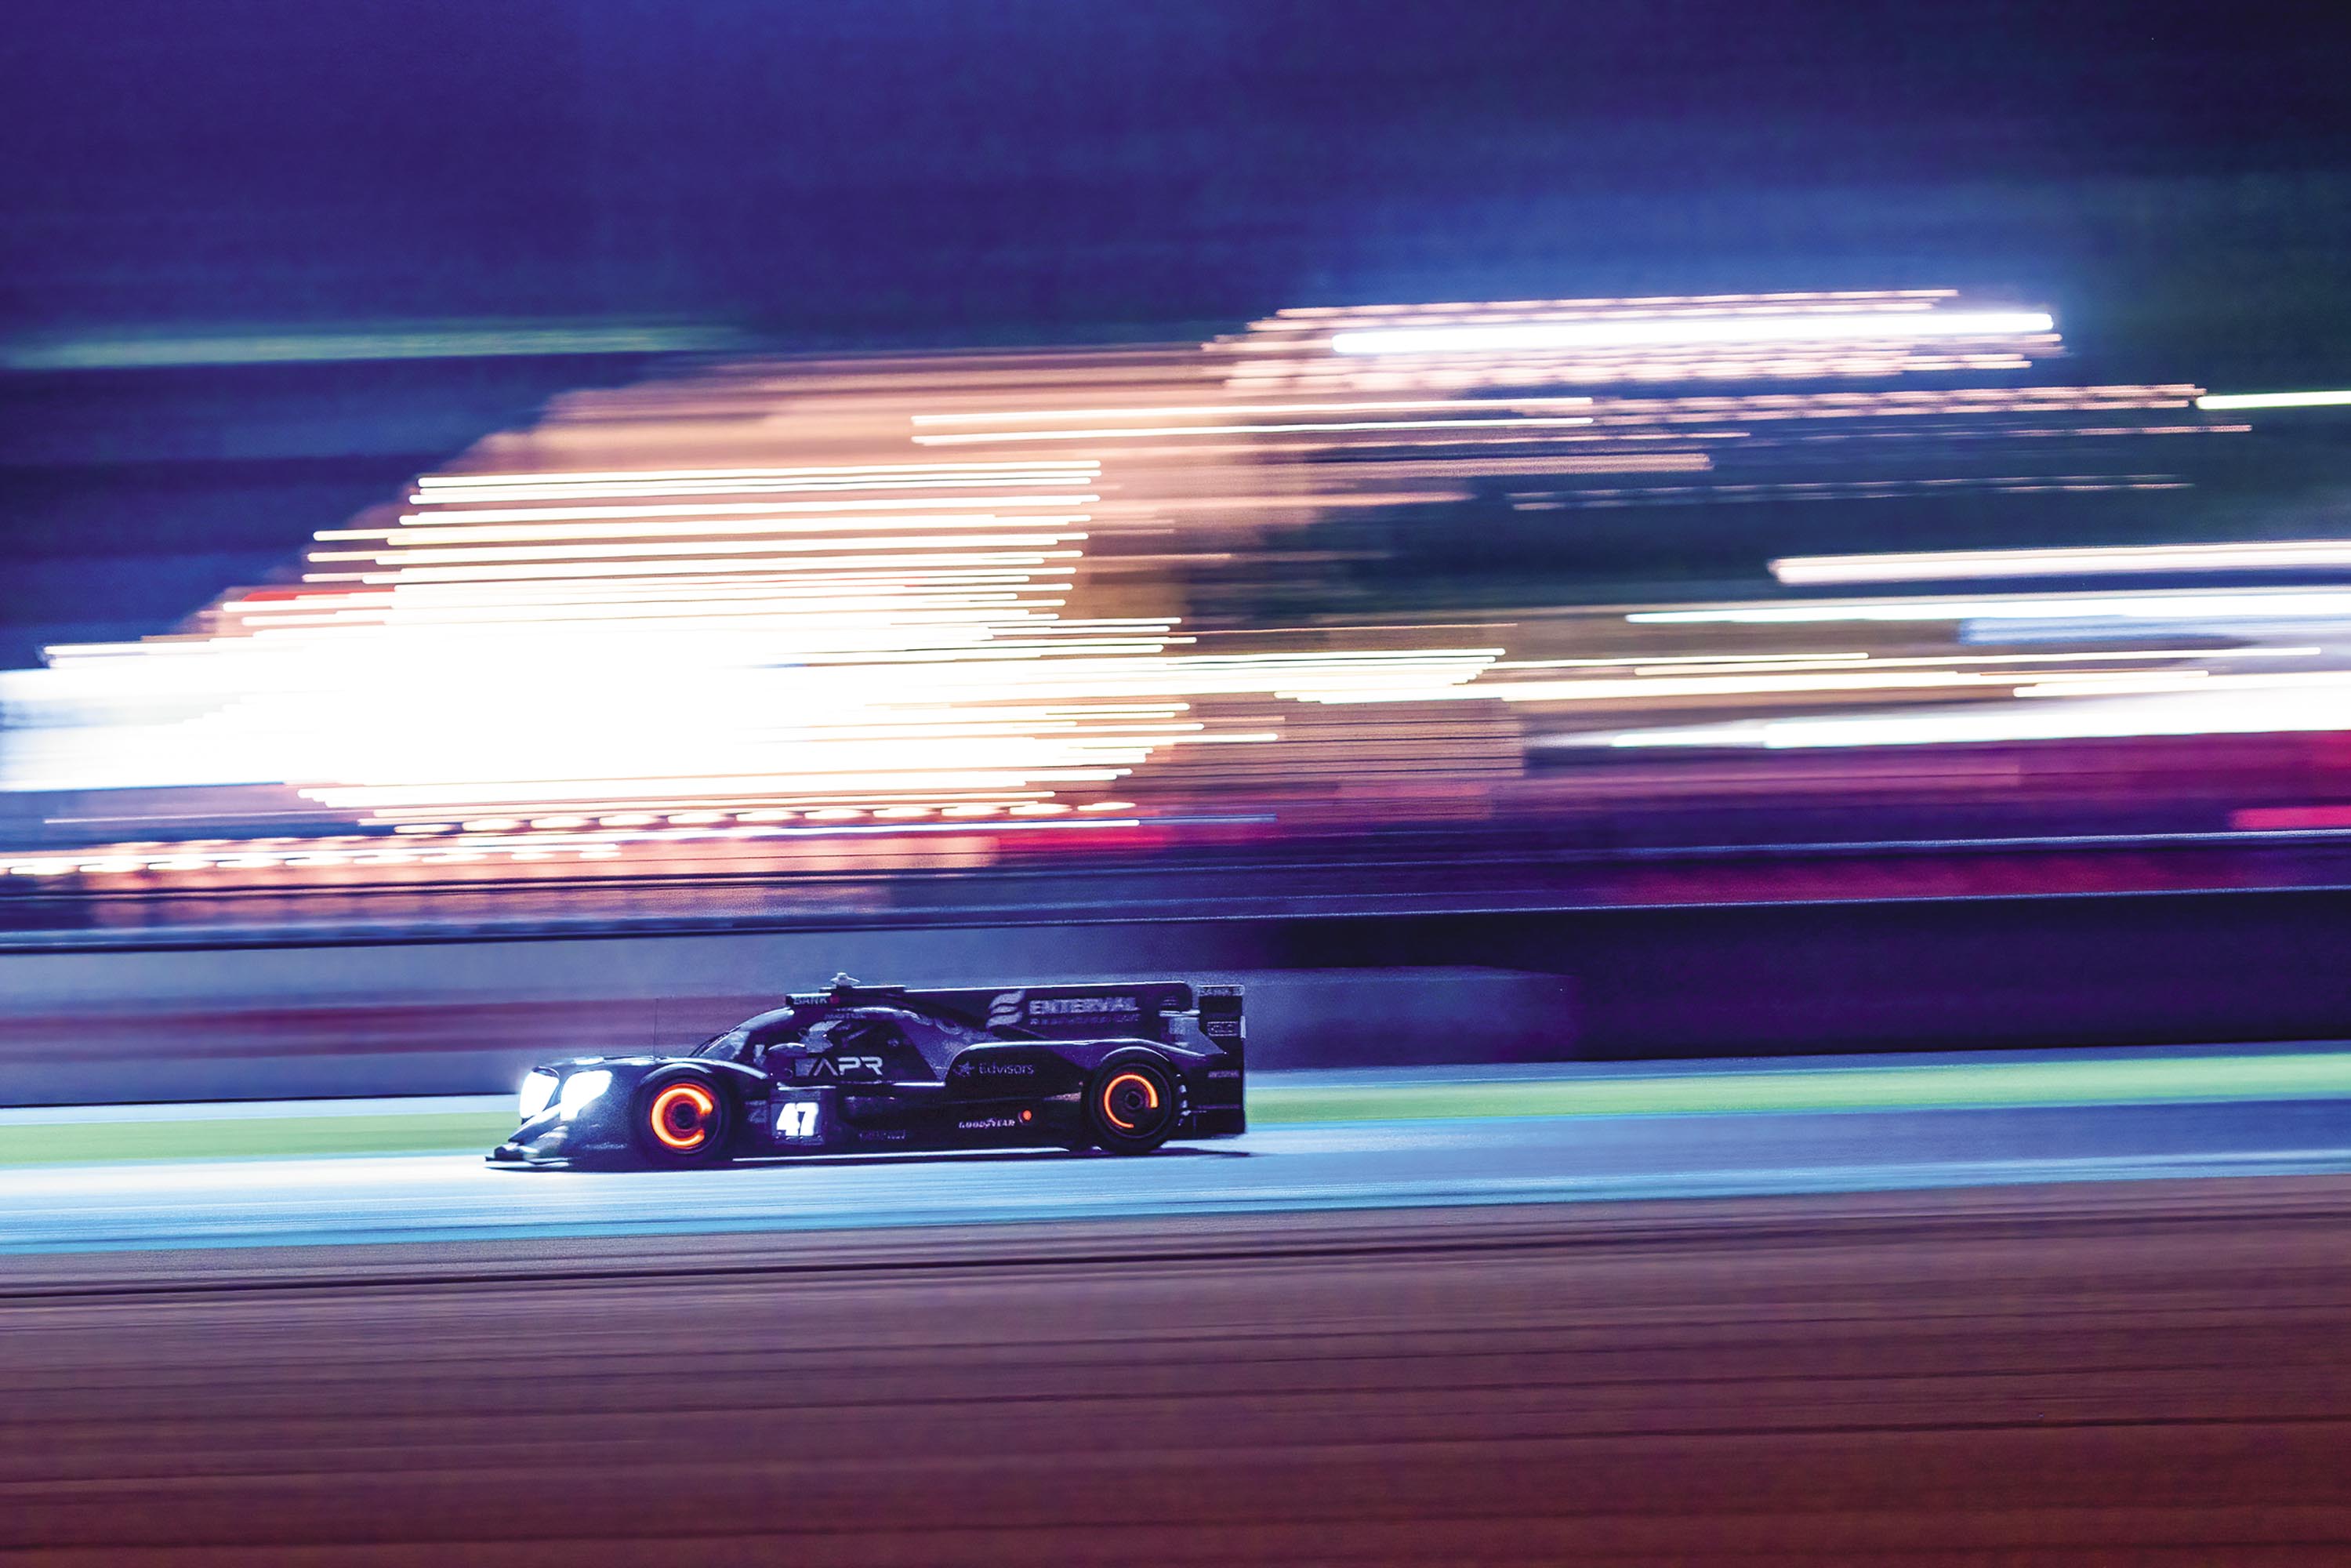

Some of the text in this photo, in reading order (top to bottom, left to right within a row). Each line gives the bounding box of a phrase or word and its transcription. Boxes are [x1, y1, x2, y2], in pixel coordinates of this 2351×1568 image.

[813, 1055, 883, 1077] APR
[775, 1102, 820, 1137] 47
[958, 1118, 1016, 1130] GOODYEAR
